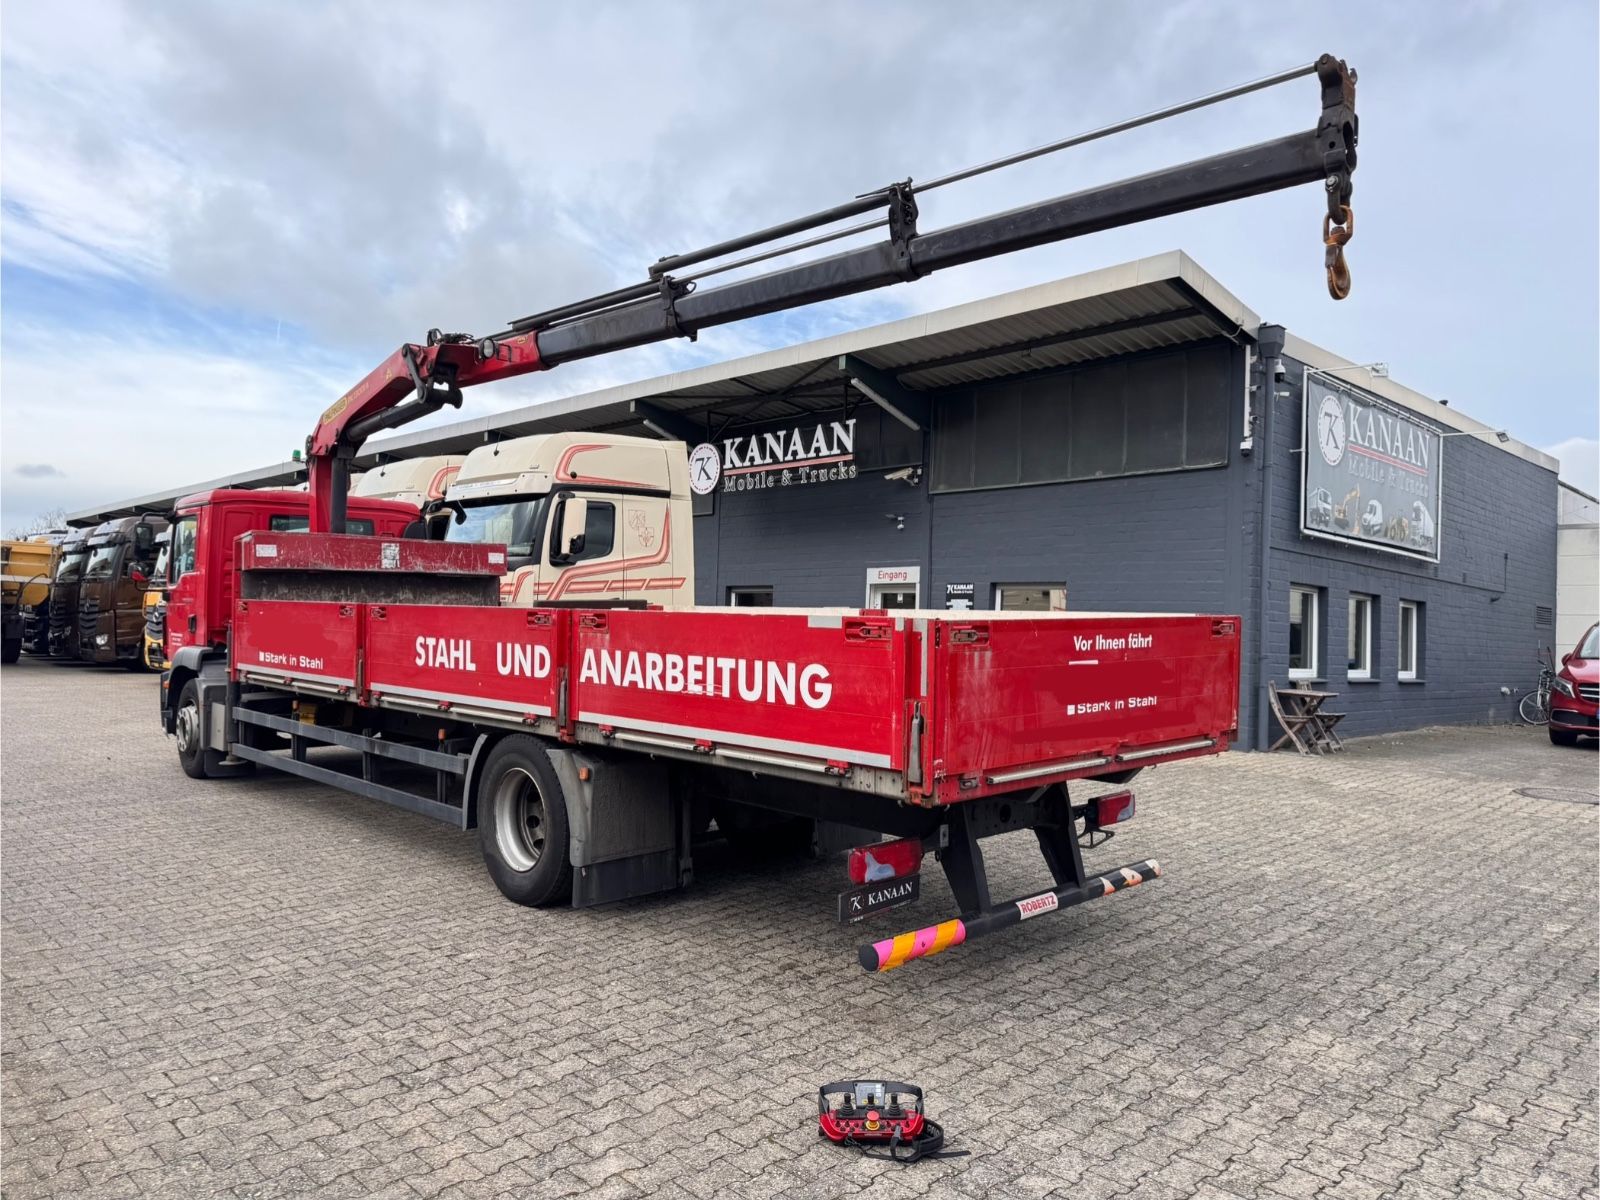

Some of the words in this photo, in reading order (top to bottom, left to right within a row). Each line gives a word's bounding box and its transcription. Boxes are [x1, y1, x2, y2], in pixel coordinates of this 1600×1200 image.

[723, 419, 857, 469] KANAAN
[1348, 402, 1430, 468] KANAAN
[724, 471, 775, 493] Mobile
[781, 469, 792, 486] &
[799, 462, 857, 485] Trucks
[877, 570, 908, 581] Eingang
[1073, 635, 1093, 651] Vor
[1095, 634, 1126, 651] Ihnen
[1127, 632, 1153, 649] fährt
[265, 652, 287, 664] Stark
[289, 654, 297, 666] in
[299, 655, 324, 670] Stahl
[415, 635, 477, 672] STAHL
[496, 641, 551, 679] UND
[579, 648, 833, 710] ANARBEITUNG
[1077, 700, 1111, 714] Stark
[1115, 700, 1125, 710] in
[1128, 696, 1158, 708] Stahl
[868, 881, 913, 906] KANAAN
[1020, 895, 1056, 914] ROBERTZ
